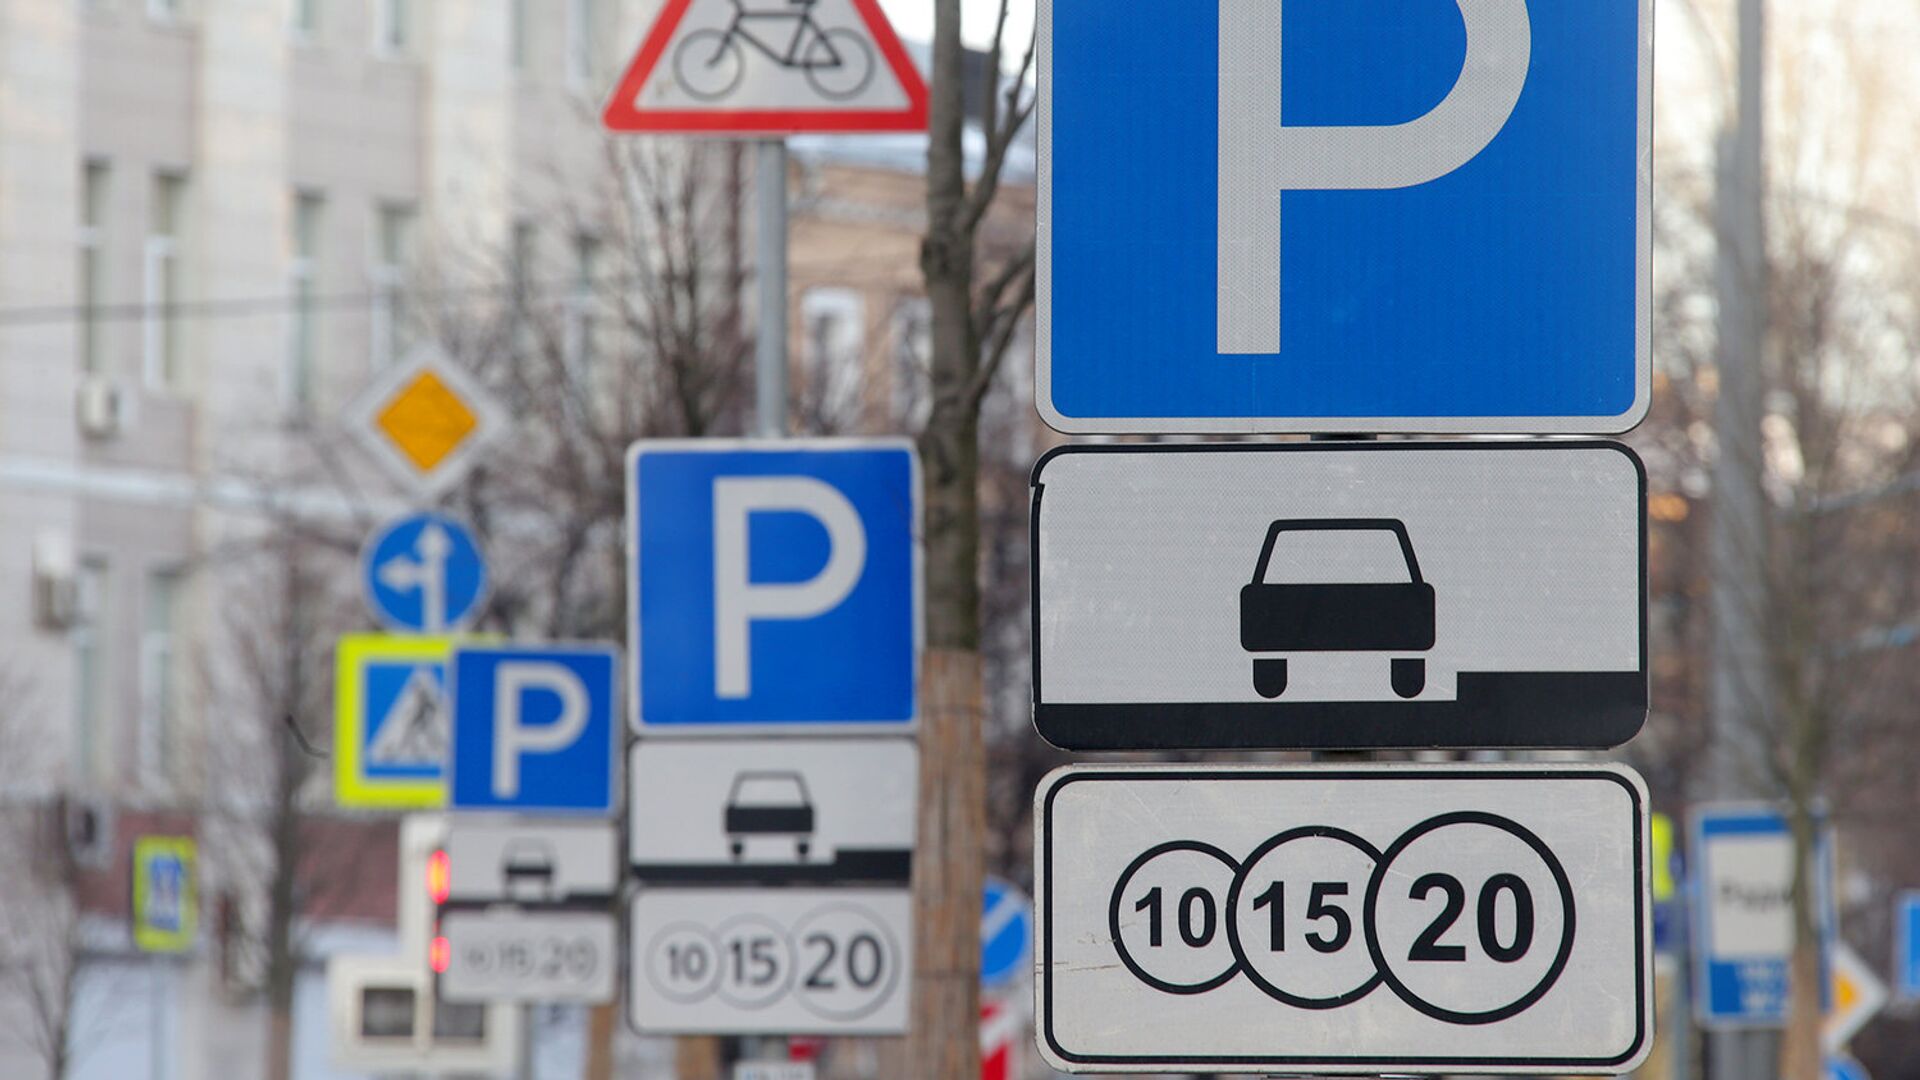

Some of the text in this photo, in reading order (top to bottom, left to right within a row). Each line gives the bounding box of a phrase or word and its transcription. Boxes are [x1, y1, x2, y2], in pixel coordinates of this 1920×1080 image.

[1217, 0, 1532, 355] P
[713, 477, 867, 700] P
[493, 663, 590, 798] P
[538, 938, 595, 979] 20
[667, 933, 884, 991] 10 15 20
[1134, 871, 1535, 964] 10 15 20
